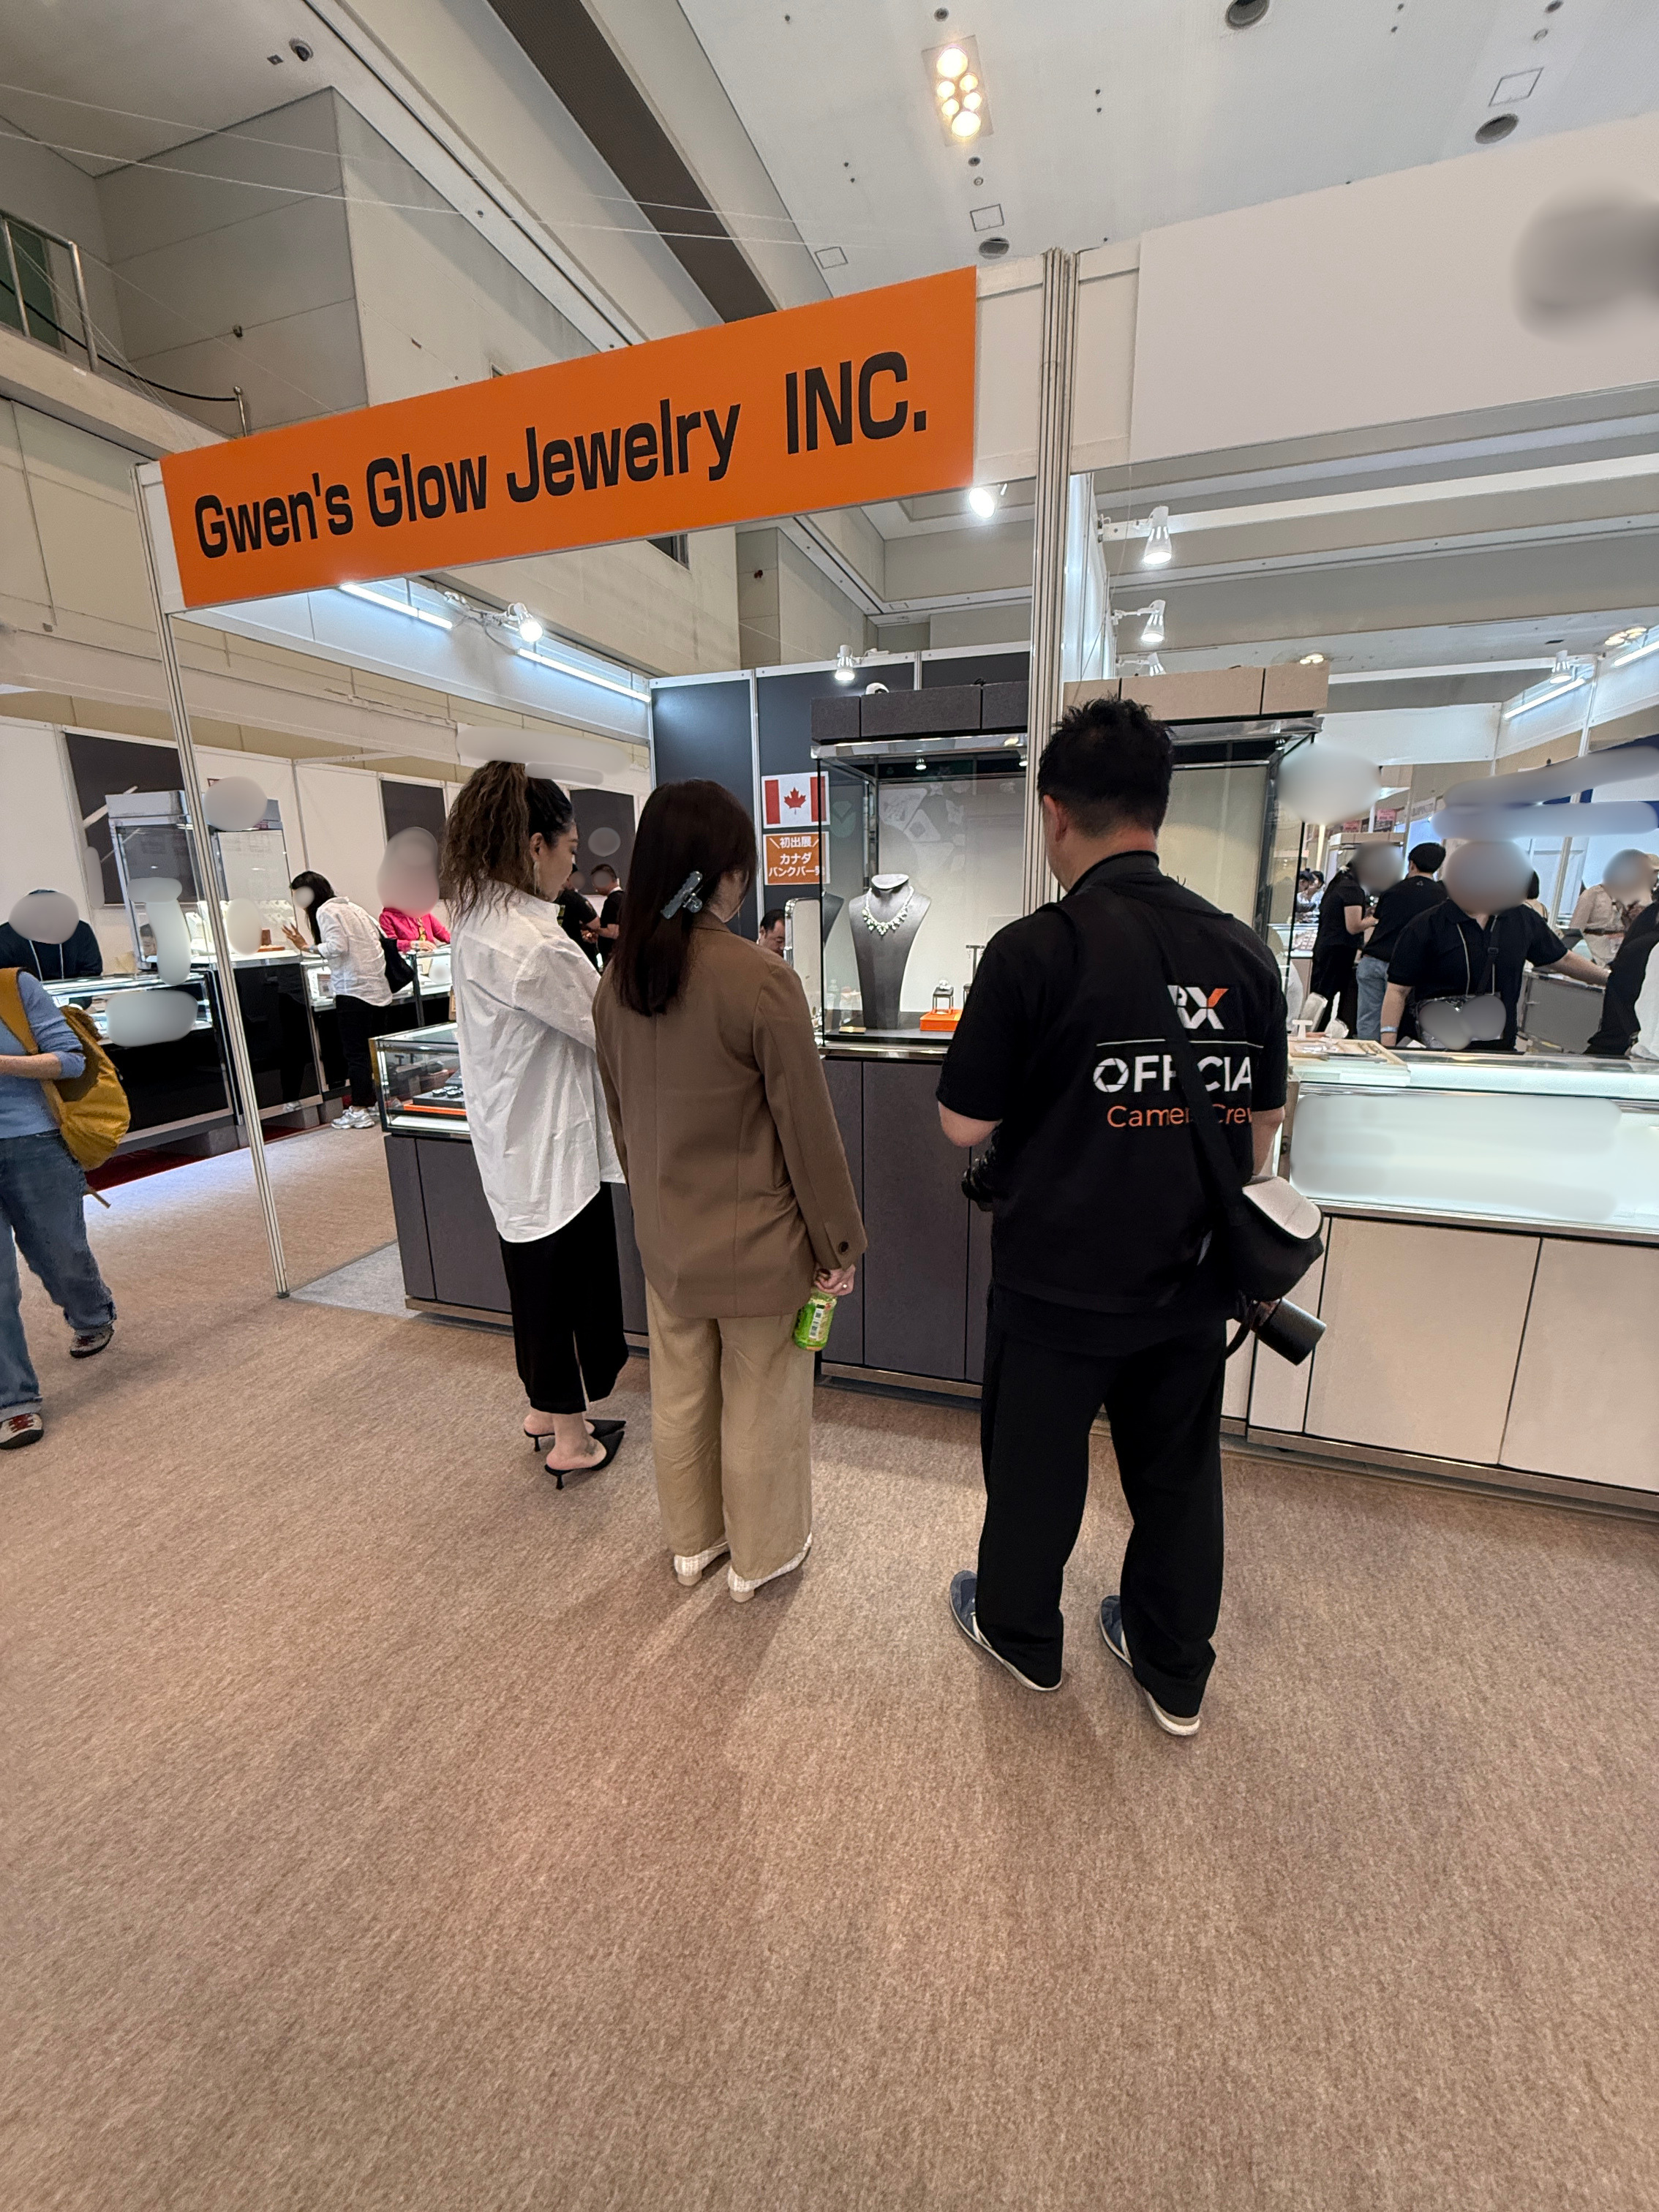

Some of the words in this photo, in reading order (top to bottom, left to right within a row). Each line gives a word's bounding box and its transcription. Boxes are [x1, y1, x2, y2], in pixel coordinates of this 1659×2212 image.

[195, 472, 353, 559] Gwen's
[366, 453, 487, 527] Glow
[506, 398, 741, 503] Jewelry
[786, 351, 927, 455] INC.
[779, 852, 813, 865] カナダ
